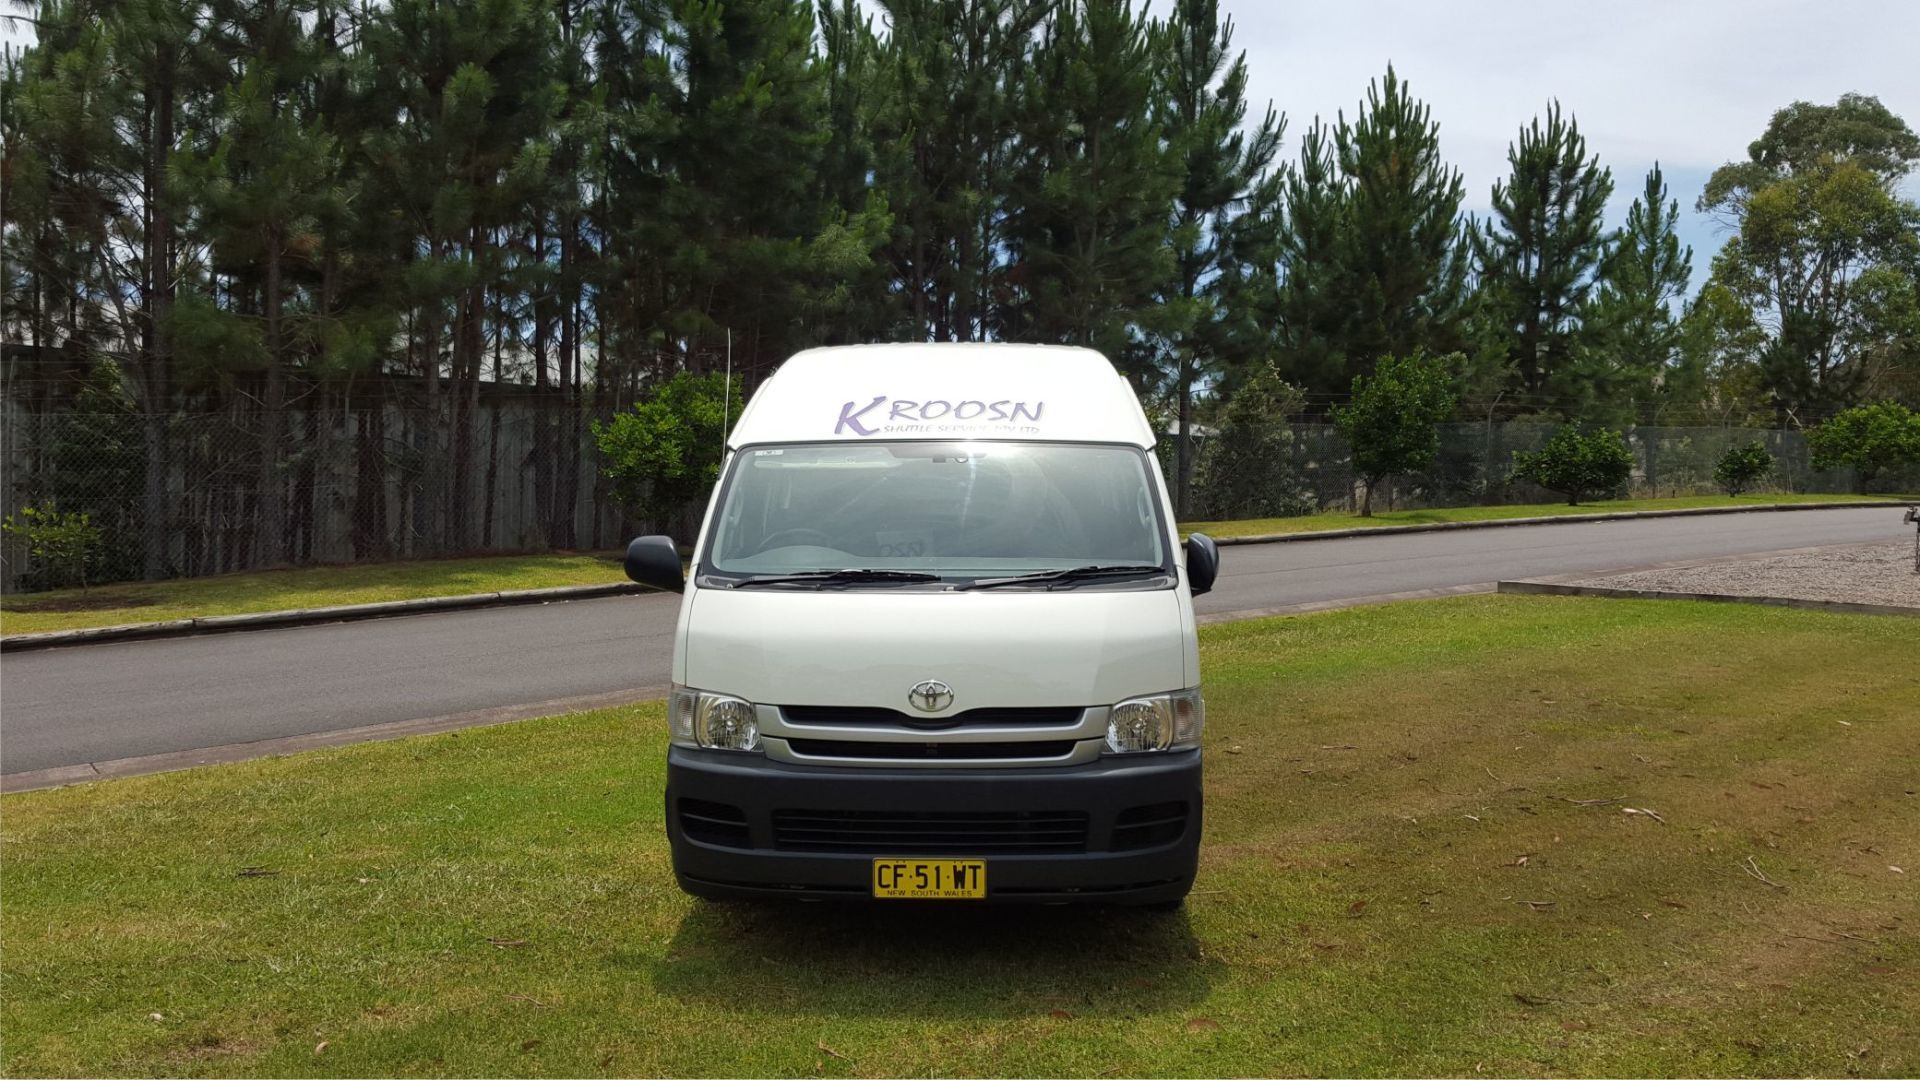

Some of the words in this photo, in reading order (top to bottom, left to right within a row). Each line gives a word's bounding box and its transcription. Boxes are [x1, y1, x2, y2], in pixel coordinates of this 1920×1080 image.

[834, 396, 1044, 436] KROOSN
[884, 424, 933, 433] SHUTTLE
[1019, 425, 1040, 434] LTD
